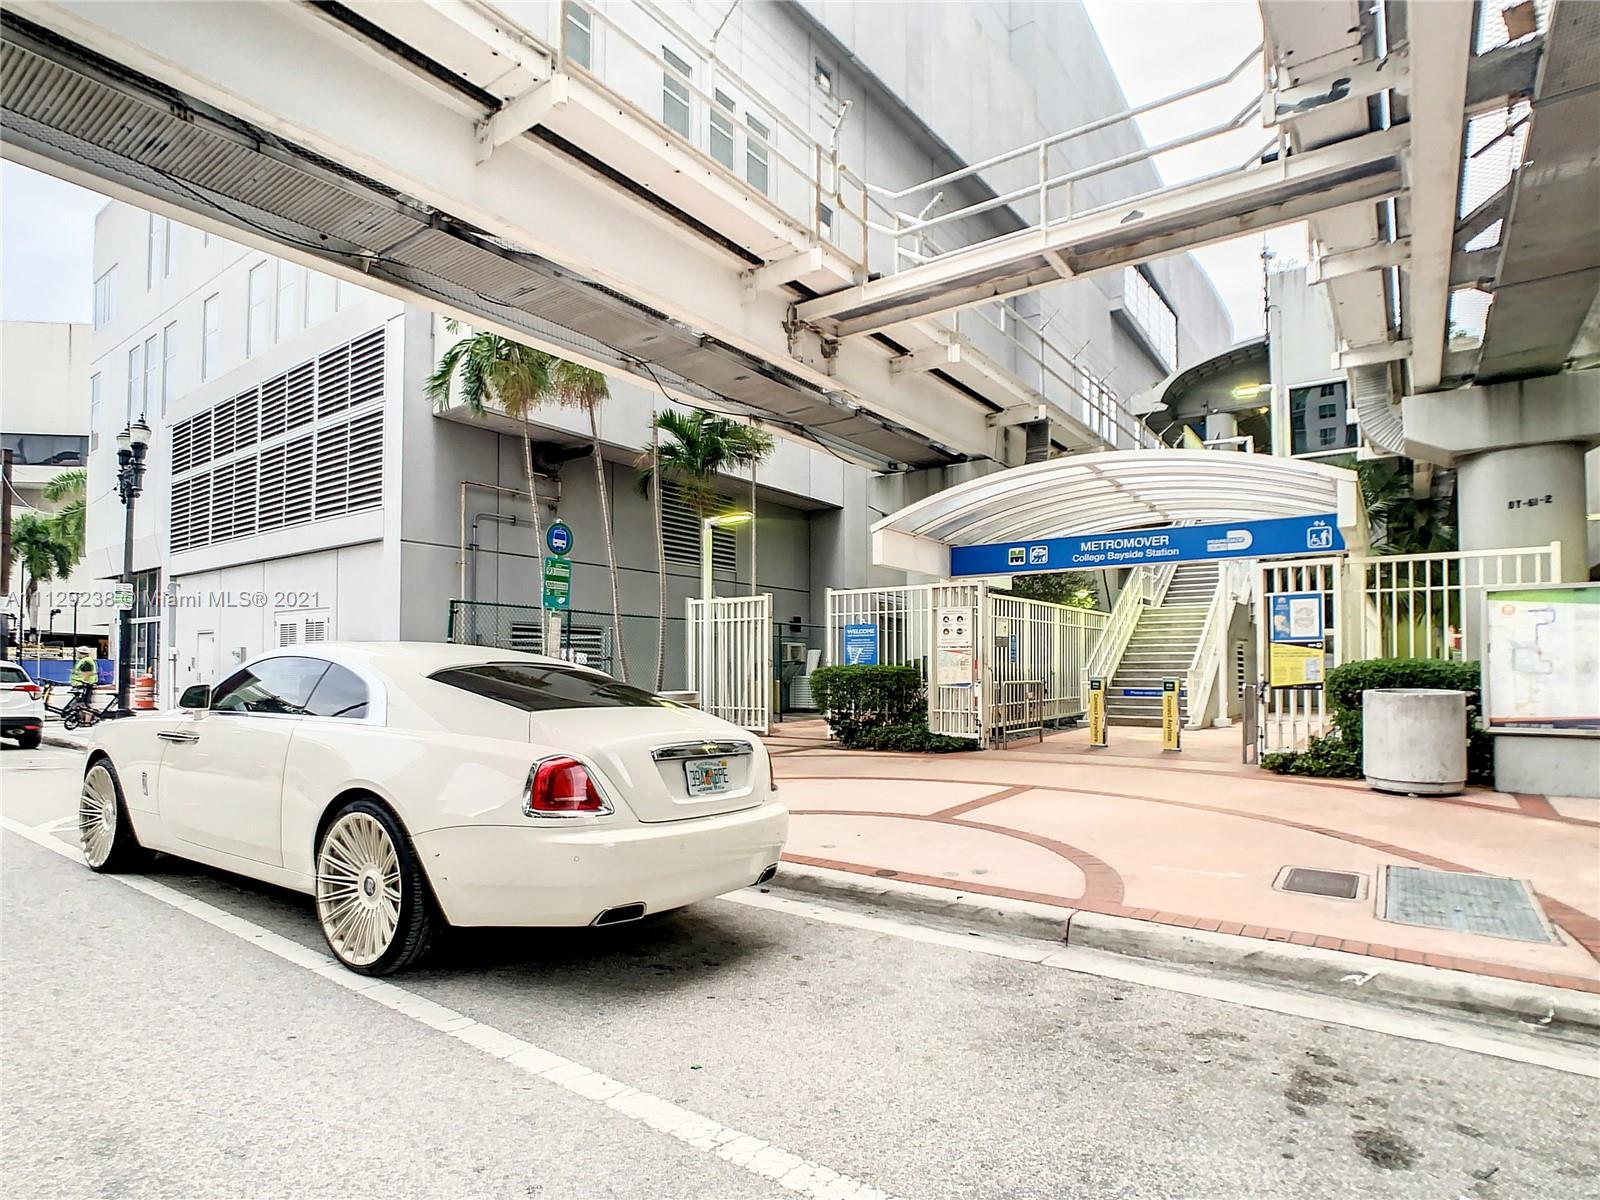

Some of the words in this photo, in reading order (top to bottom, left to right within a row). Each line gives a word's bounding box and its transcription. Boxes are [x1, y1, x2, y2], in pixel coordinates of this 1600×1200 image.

[1080, 535, 1169, 551] METROMOVER
[1072, 551, 1106, 563] College
[1107, 550, 1144, 561] Bayside
[1145, 547, 1180, 557] Station
